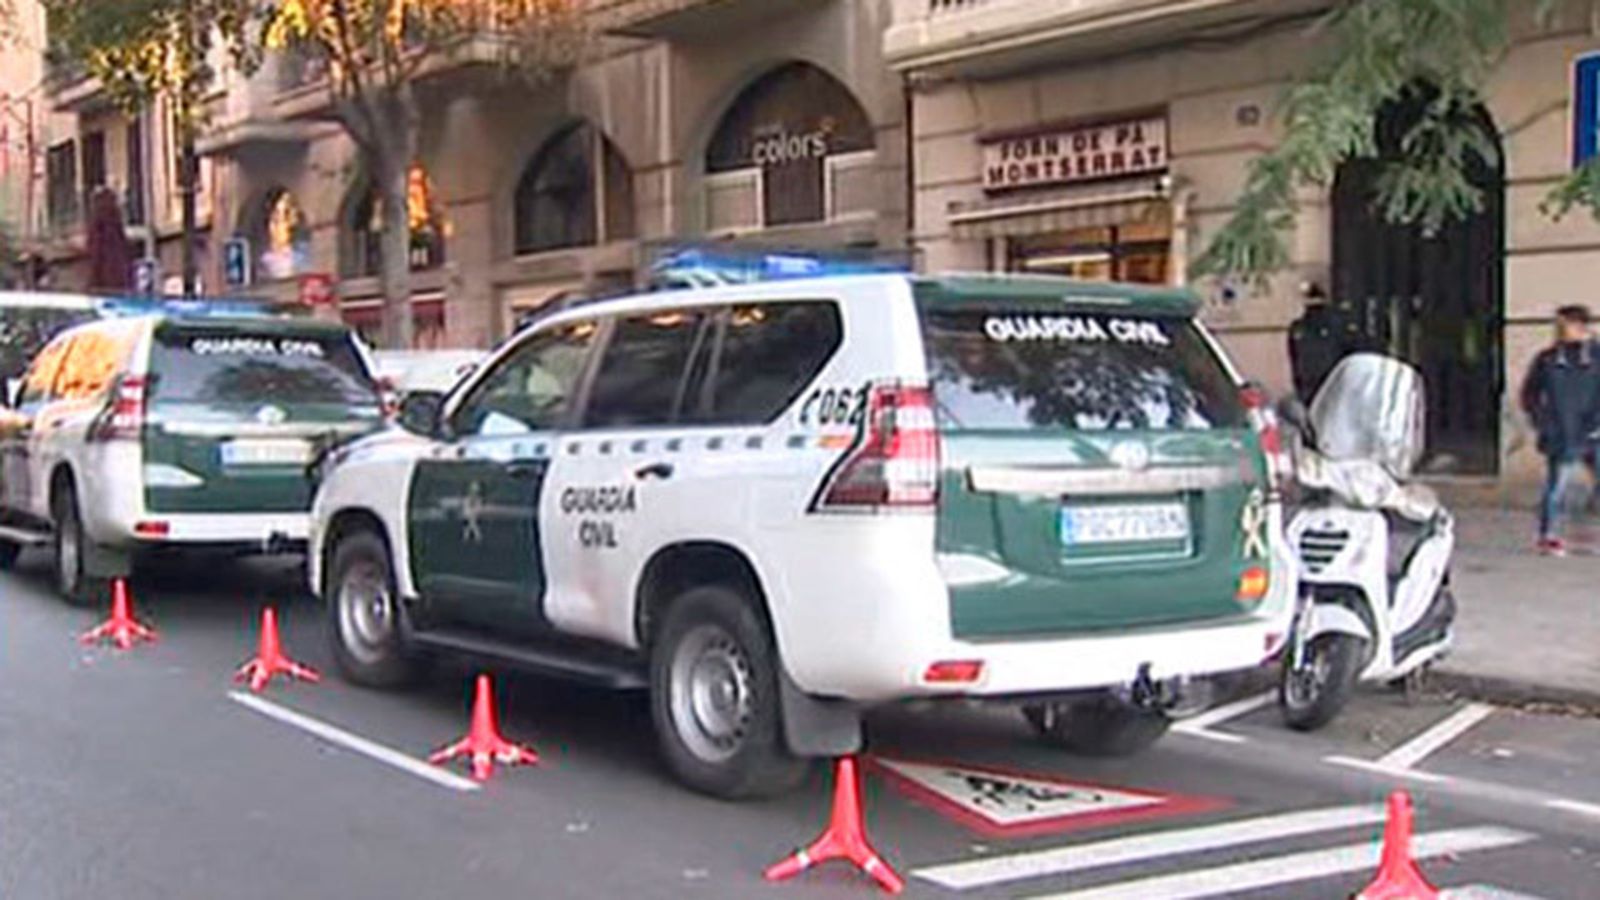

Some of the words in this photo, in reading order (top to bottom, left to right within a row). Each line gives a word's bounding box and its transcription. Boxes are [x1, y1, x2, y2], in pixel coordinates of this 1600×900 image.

[752, 131, 827, 166] colors
[1000, 137, 1059, 161] FORN
[1073, 132, 1100, 152] DE
[987, 145, 1161, 184] MONTSERRAT
[984, 316, 1108, 342] GUARDIA
[1108, 318, 1171, 346] CIVIL
[192, 338, 280, 356] GUARDIA
[280, 339, 325, 357] CIVIL
[560, 486, 636, 513] GUARDIA
[579, 520, 618, 548] CIVIL
